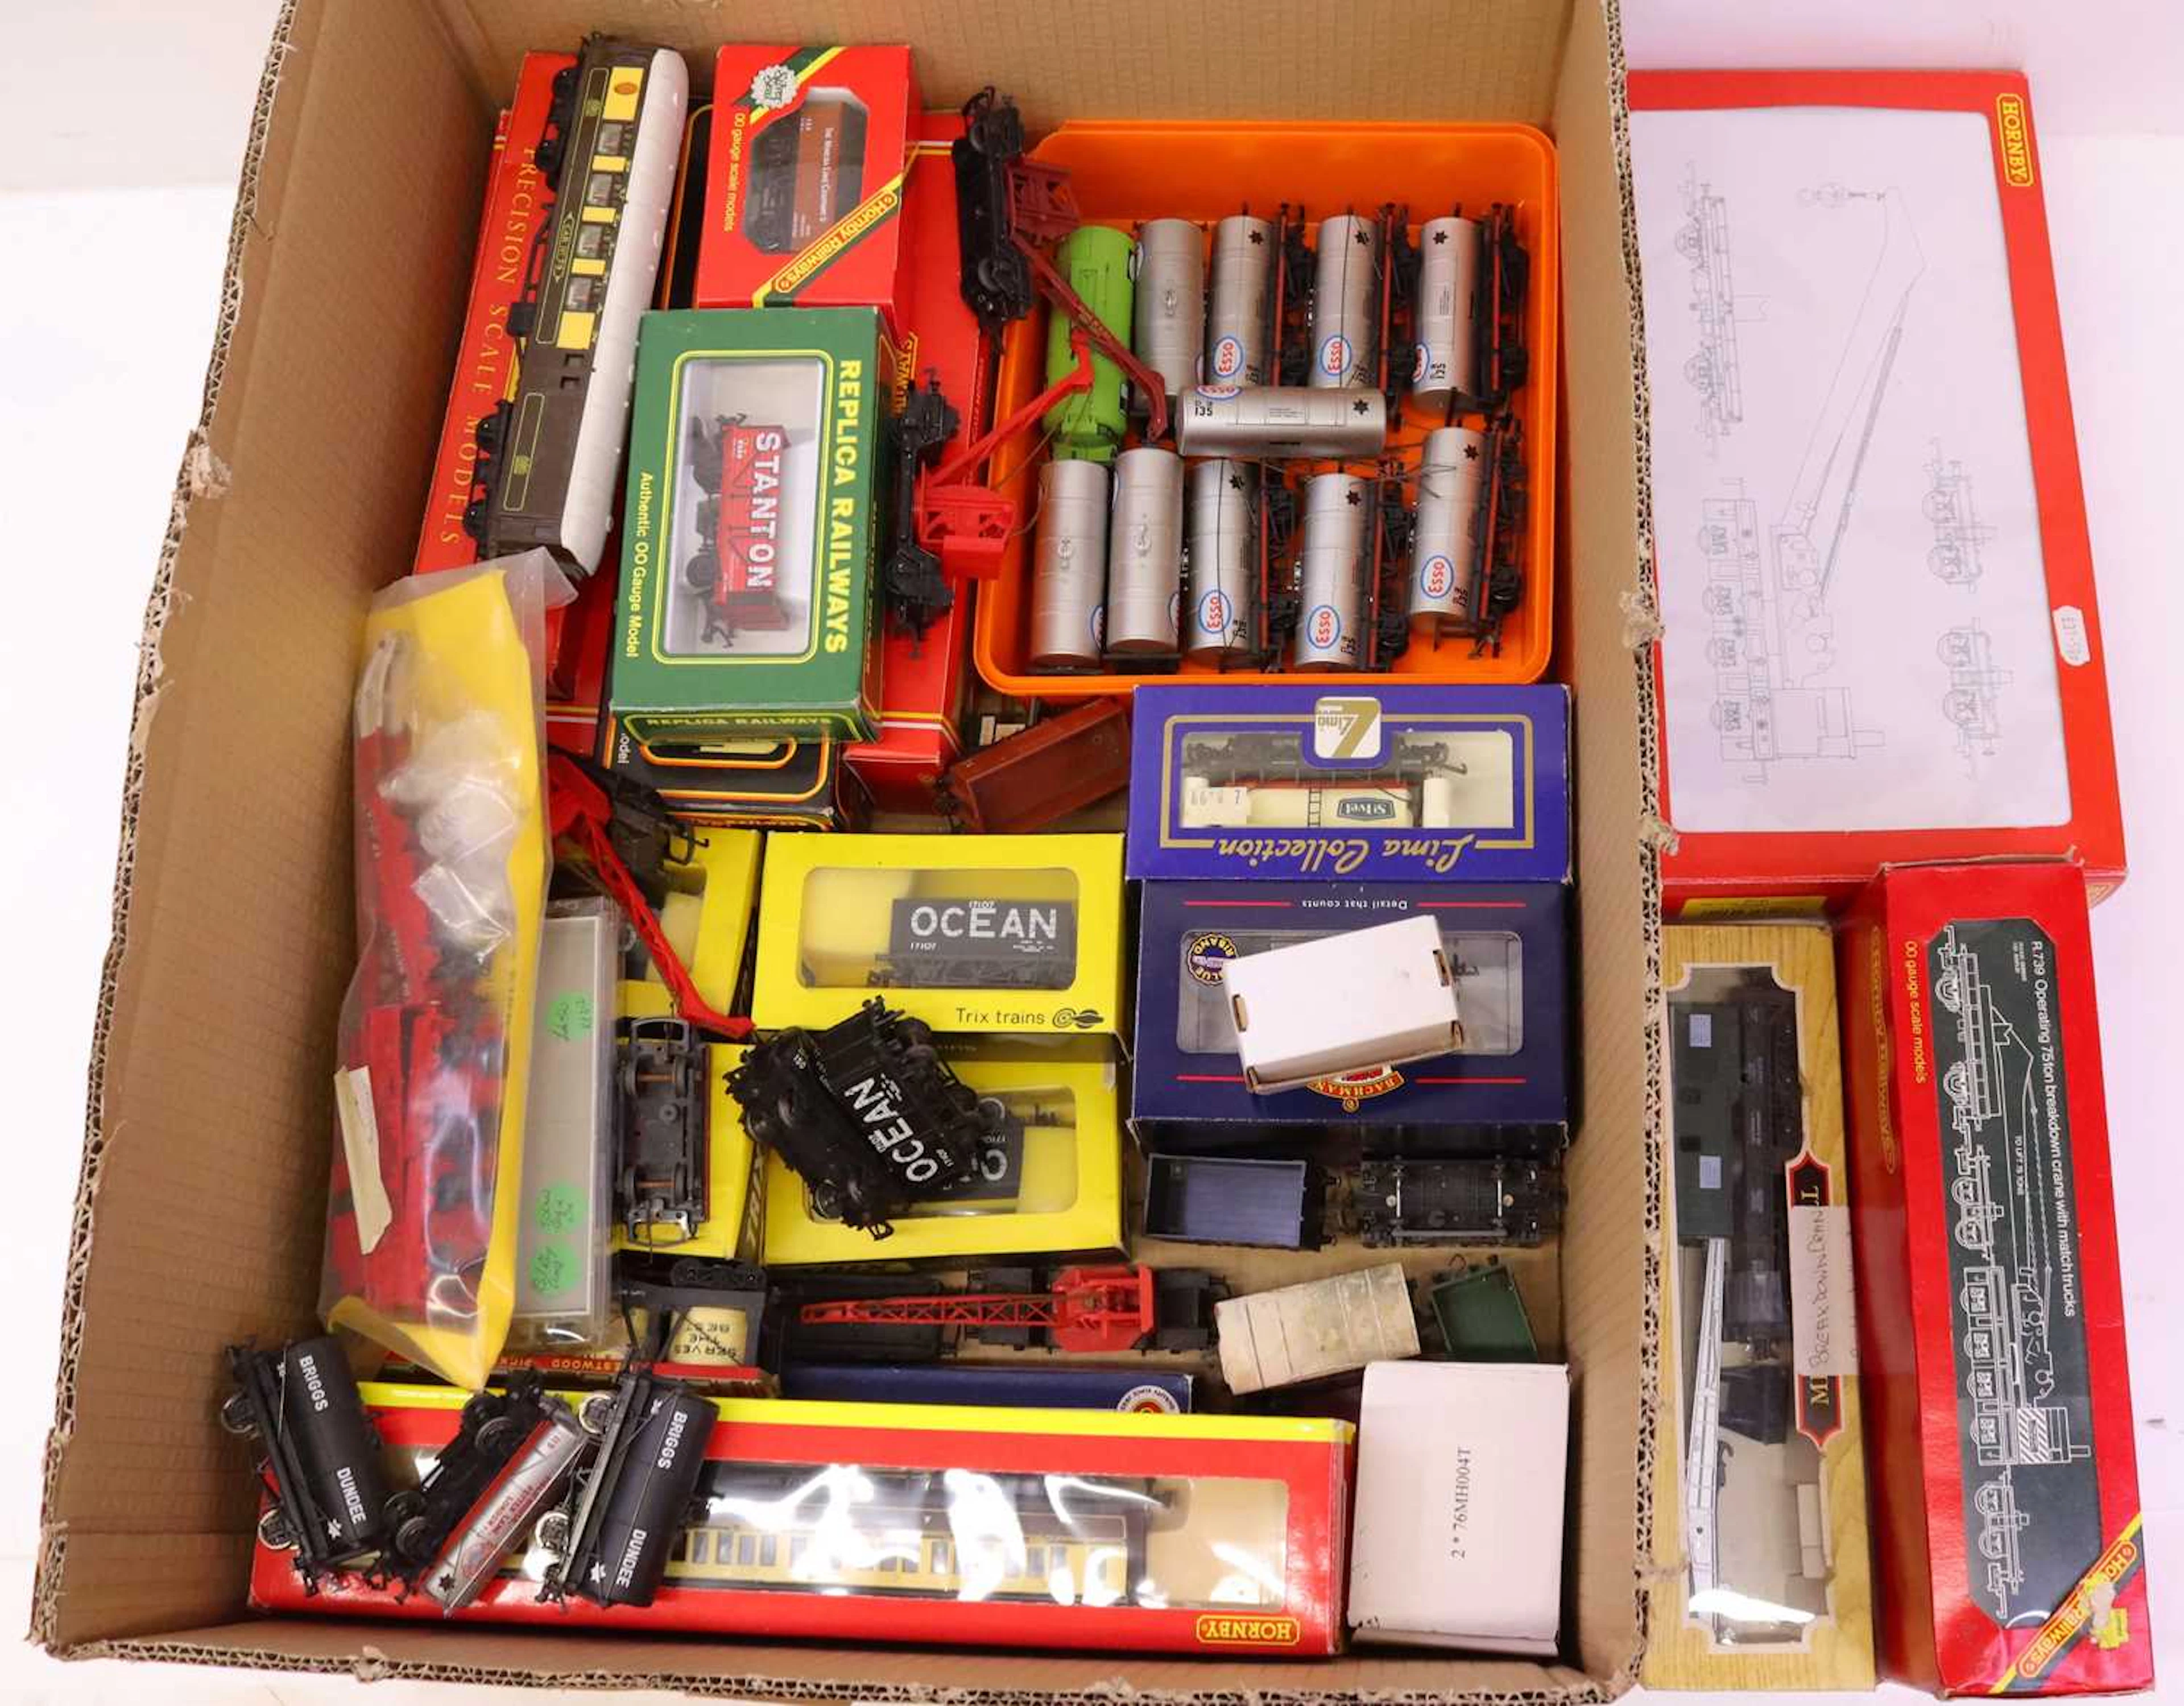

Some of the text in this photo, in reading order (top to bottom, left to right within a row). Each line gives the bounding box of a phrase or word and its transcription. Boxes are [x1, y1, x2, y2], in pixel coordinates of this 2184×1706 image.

[729, 129, 742, 161] gauge
[2003, 102, 2027, 178] HORNBY
[727, 162, 739, 190] scale
[723, 192, 737, 233] models
[841, 199, 884, 238] Hornby
[786, 234, 843, 281] Railways
[473, 303, 508, 395] SCALE
[441, 415, 481, 544] MODELS
[638, 471, 655, 537] Authentic
[746, 430, 782, 589] STANTON
[825, 360, 862, 653] REPLICA RAILWAYS
[628, 566, 647, 611] Gauge
[626, 615, 643, 657] Model
[1317, 716, 1354, 736] Lima
[617, 733, 630, 764] odel
[1217, 834, 1477, 875] Lima Collection
[910, 905, 1057, 939] OCEAN
[1301, 899, 1408, 910] Detail that counts
[1193, 934, 1236, 958] RIBAND
[1905, 960, 1921, 999] gauge
[956, 1008, 1045, 1025] Trix trains
[1910, 1000, 1924, 1032] scale
[2034, 978, 2051, 1044] Operating
[1913, 1033, 1927, 1084] models
[844, 1077, 938, 1182] OCEAN
[2045, 1084, 2062, 1159] breakdown
[2052, 1162, 2064, 1198] crane
[2055, 1199, 2071, 1229] with
[2058, 1230, 2074, 1274] match
[2061, 1274, 2076, 1318] trucks
[298, 1355, 329, 1413] BRIGGS
[657, 1411, 689, 1469] BRIGGS
[336, 1468, 367, 1526] DUNDEE
[1451, 1447, 1471, 1560] 2 76MH004T
[617, 1529, 648, 1589] DUNDEE
[1205, 1620, 1293, 1640] HORNBY
